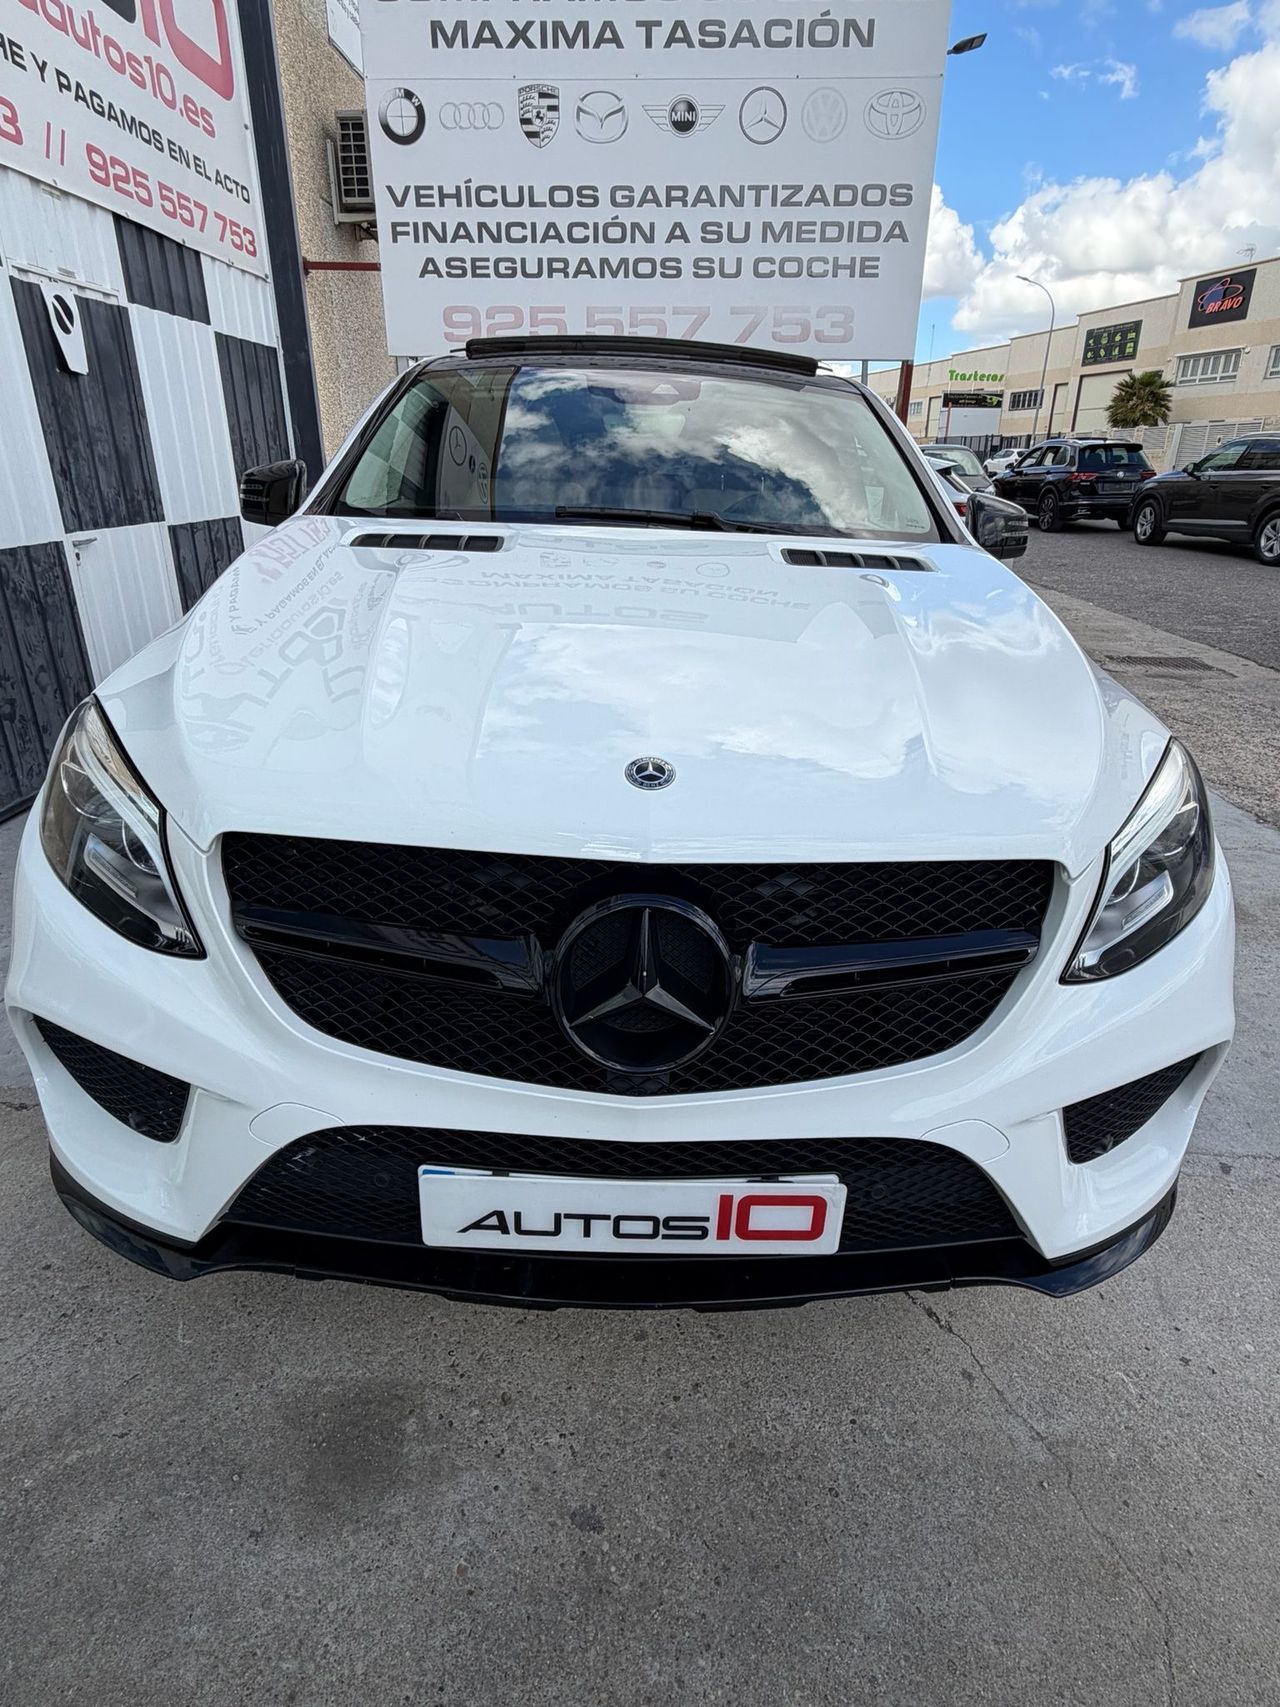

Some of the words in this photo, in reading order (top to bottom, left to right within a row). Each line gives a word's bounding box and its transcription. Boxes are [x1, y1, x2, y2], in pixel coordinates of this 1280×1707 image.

[430, 20, 625, 49] MAXIMA
[635, 9, 875, 49] TASACIÓN
[30, 51, 48, 84] Y
[55, 67, 165, 153] PAGAMOS
[167, 138, 191, 169] EN
[194, 154, 212, 182] EL
[214, 169, 251, 204] ACTO
[671, 111, 696, 122] MINI
[85, 143, 153, 208] 925
[157, 181, 208, 233] 557
[214, 211, 257, 258] 753
[386, 178, 600, 208] VEHÍCULOS
[609, 183, 914, 208] GARANTIZADOS
[390, 215, 655, 244] FINANCIACIÓN
[664, 221, 691, 244] A
[700, 221, 751, 244] SU
[761, 220, 910, 243] MEDIDA
[418, 257, 683, 279] ASEGURAMOS
[692, 257, 743, 279] SU
[752, 256, 881, 279] COCHE
[1205, 296, 1244, 314] BRAVO
[442, 305, 568, 344] 925
[585, 305, 711, 341] 557
[729, 305, 856, 345] 753
